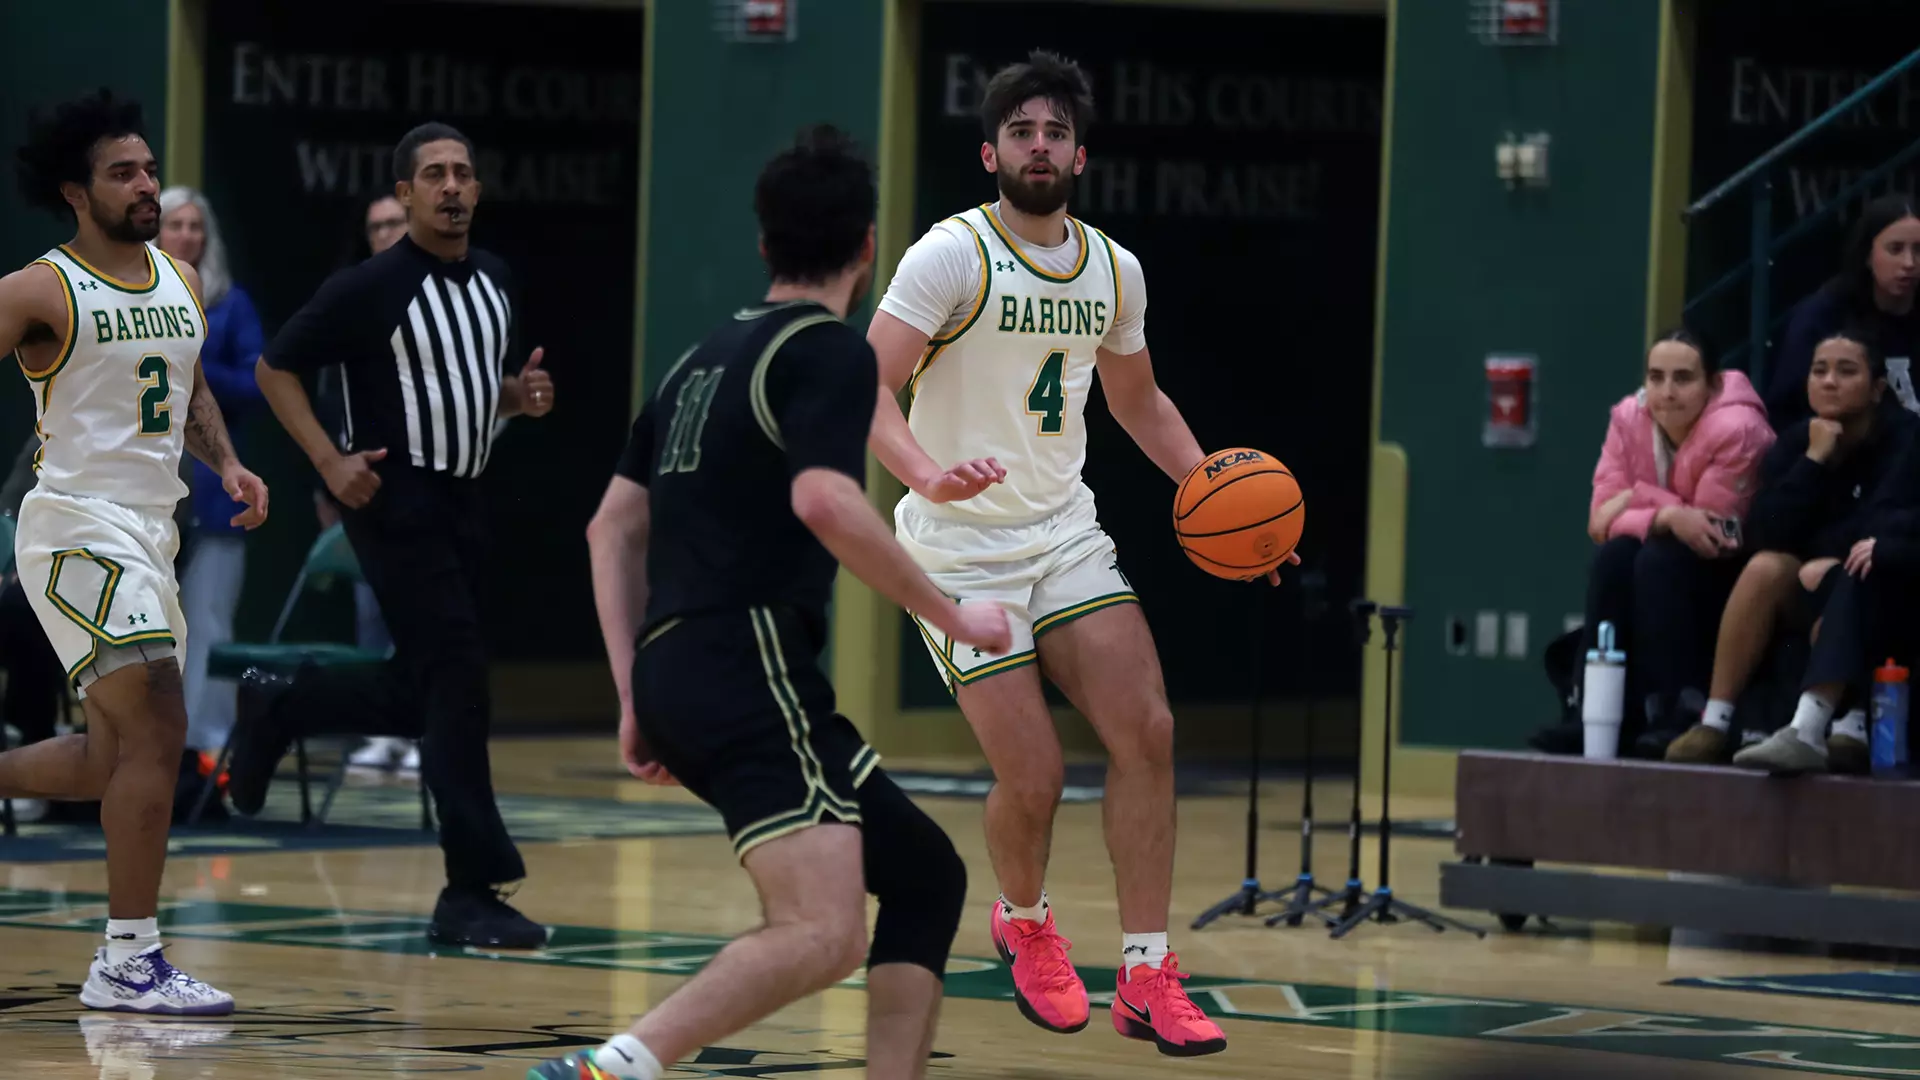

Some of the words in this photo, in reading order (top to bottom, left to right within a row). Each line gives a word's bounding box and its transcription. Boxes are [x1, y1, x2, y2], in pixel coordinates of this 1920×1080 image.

[296, 139, 396, 197] WIT
[91, 305, 197, 344] BARONS
[997, 295, 1107, 336] BARONS
[135, 352, 173, 437] 2
[657, 364, 727, 477] 11
[1024, 348, 1070, 437] 4
[1204, 451, 1265, 480] NCAA
